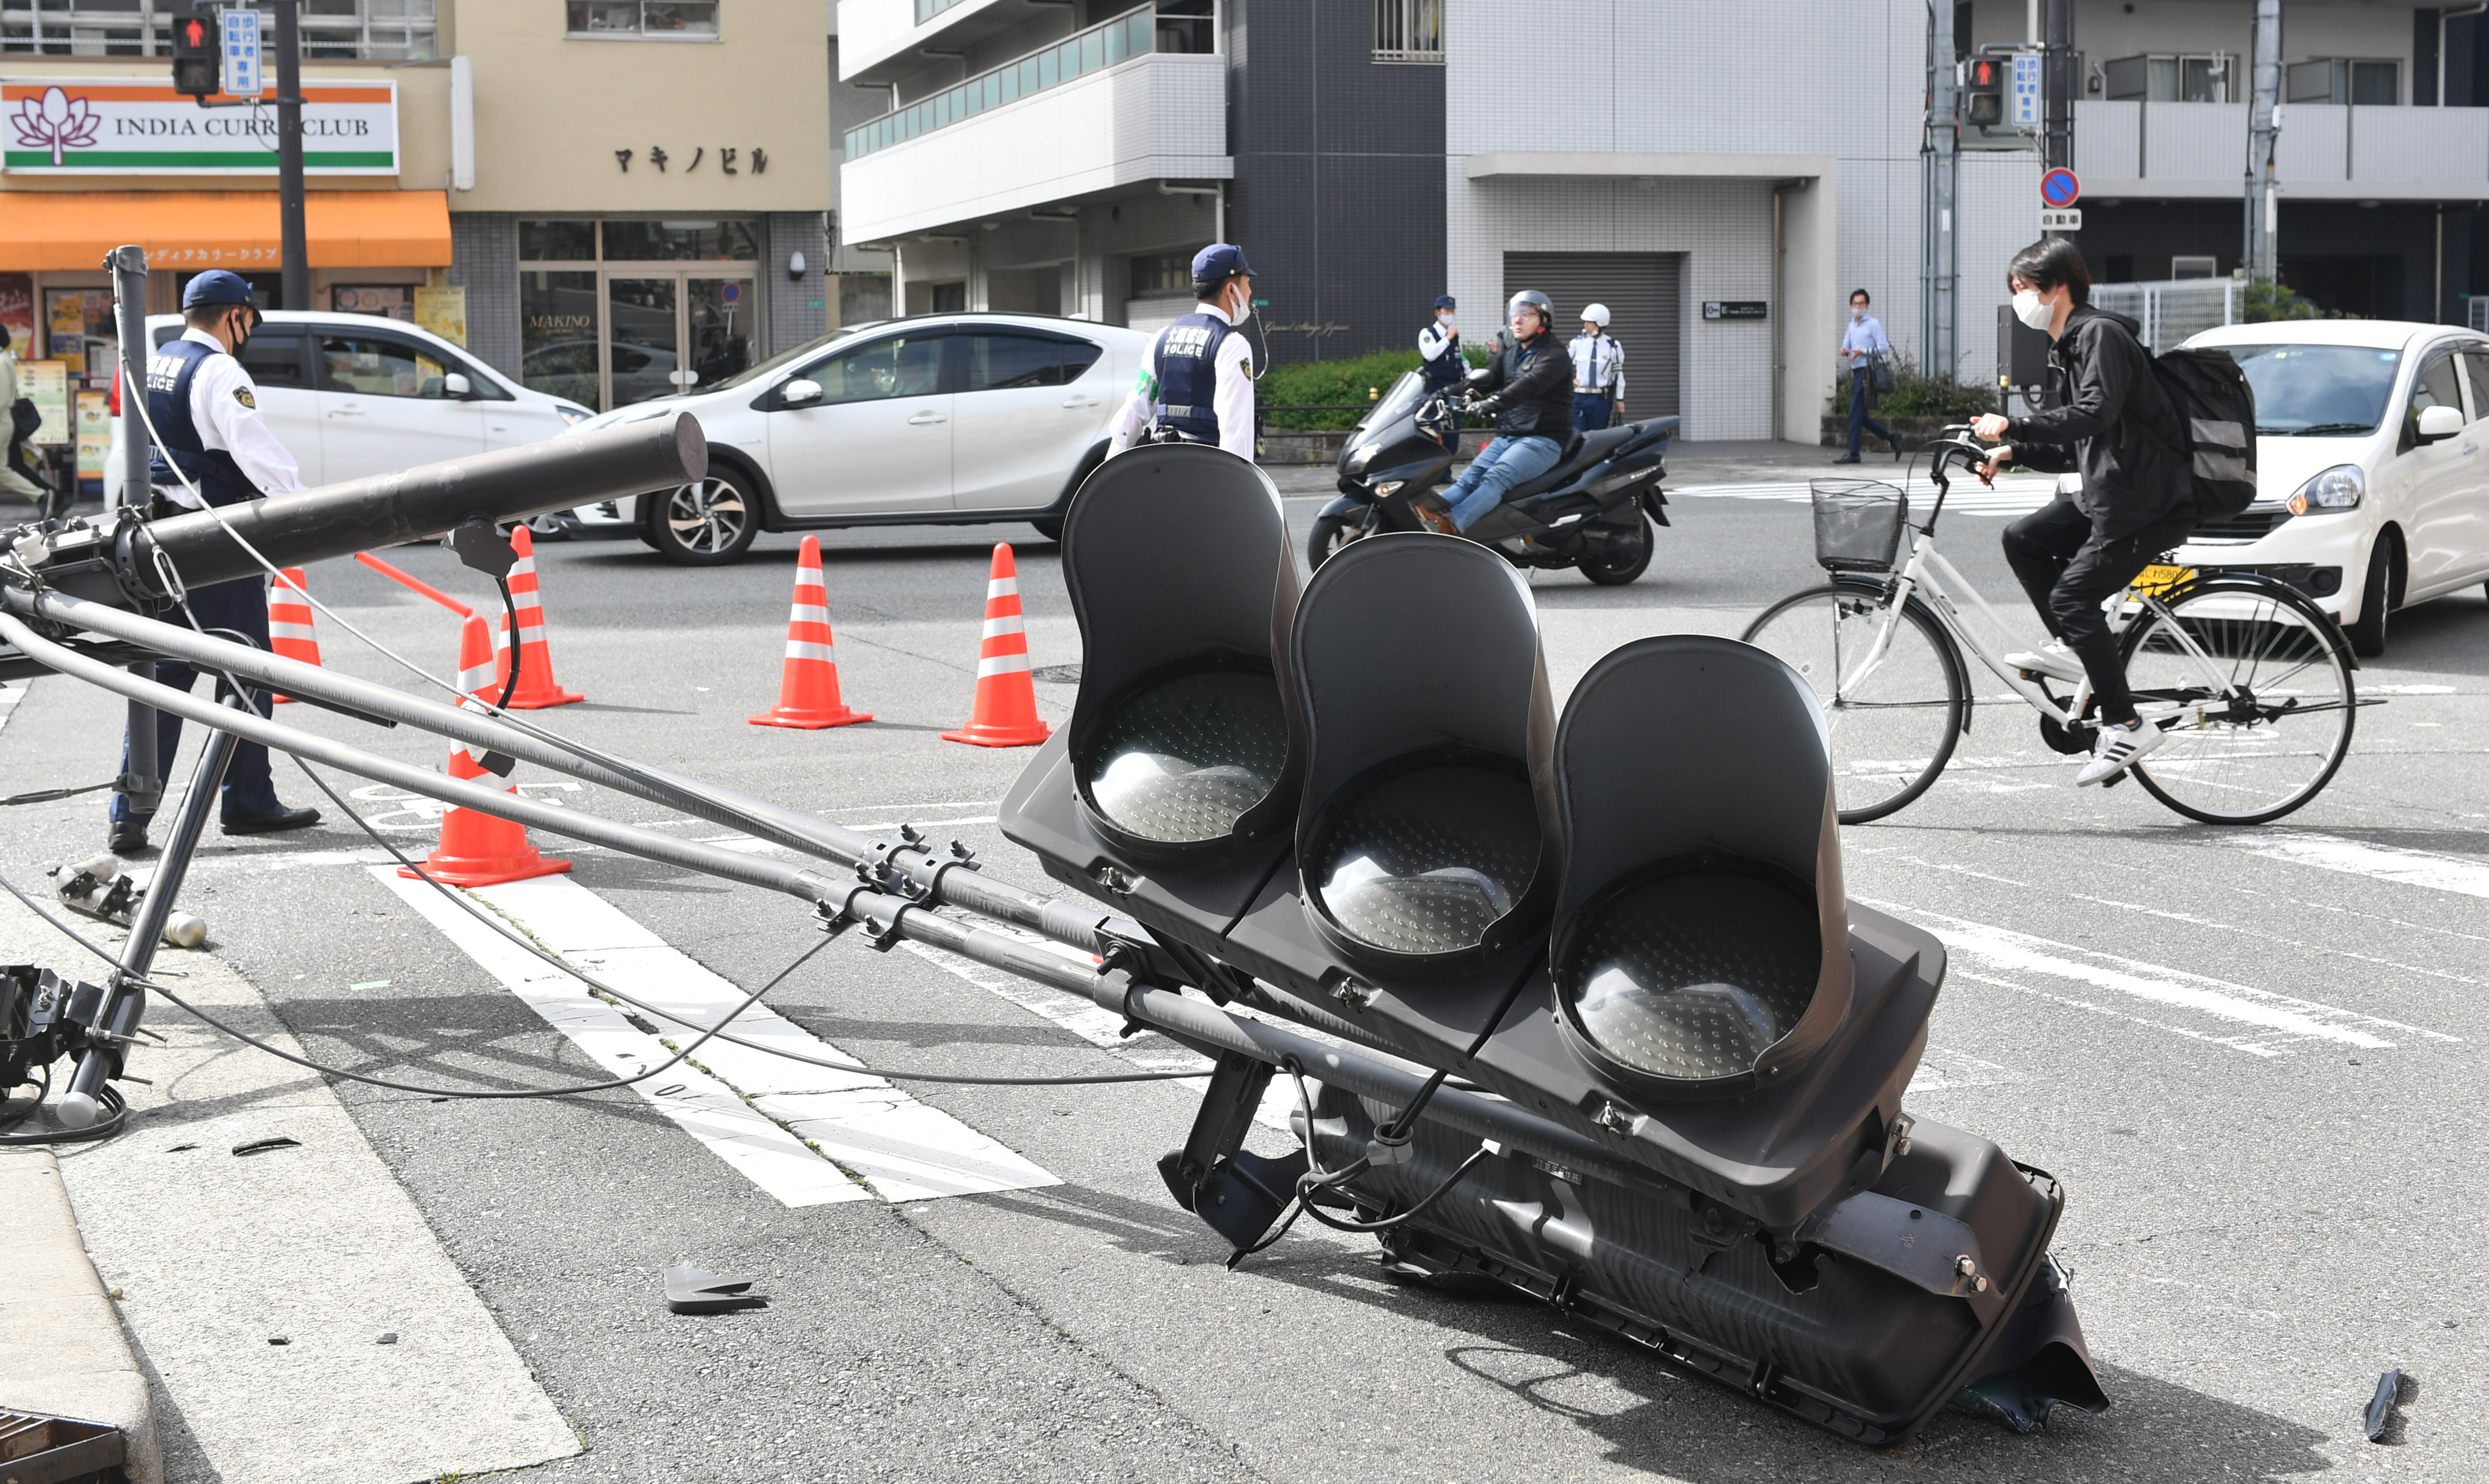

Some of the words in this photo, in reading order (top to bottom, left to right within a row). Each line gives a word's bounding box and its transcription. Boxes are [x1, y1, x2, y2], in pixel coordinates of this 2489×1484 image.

[115, 118, 197, 135] INDIA
[205, 118, 279, 136] CURR
[301, 119, 368, 136] CLUB
[615, 146, 767, 174] マキノビル
[2043, 214, 2078, 225] 自動車
[144, 248, 278, 261] ンディアカリークラブ
[529, 315, 590, 328] MAKINO
[1164, 344, 1203, 357] POLICE
[147, 375, 175, 391] LICE
